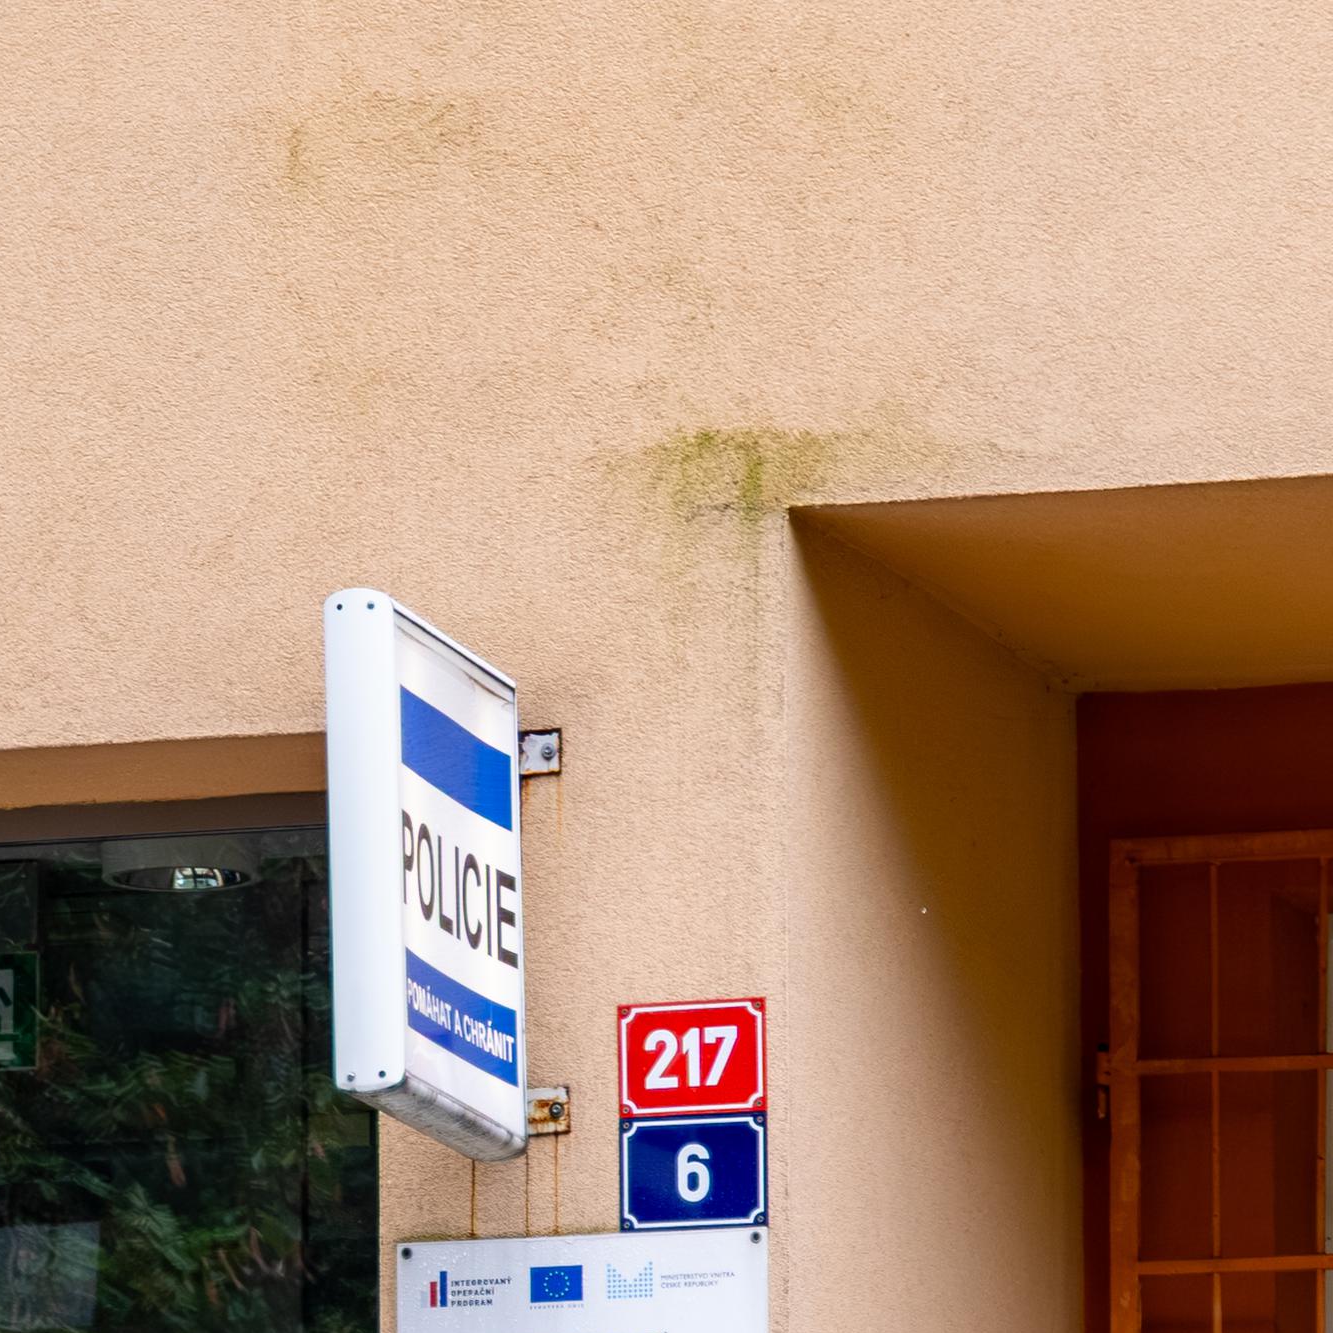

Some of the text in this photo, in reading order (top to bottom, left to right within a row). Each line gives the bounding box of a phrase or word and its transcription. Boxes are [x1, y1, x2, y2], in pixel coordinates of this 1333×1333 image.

[401, 808, 519, 969] POLICIE
[408, 977, 515, 1064] POMÁHAT A CHRÁNIT
[643, 1025, 738, 1090] 217
[676, 1143, 710, 1202] 6
[450, 1276, 513, 1288] INTEGROVANÝ
[450, 1288, 495, 1298] OPERAČNÍ
[450, 1299, 493, 1308] PROGRAM
